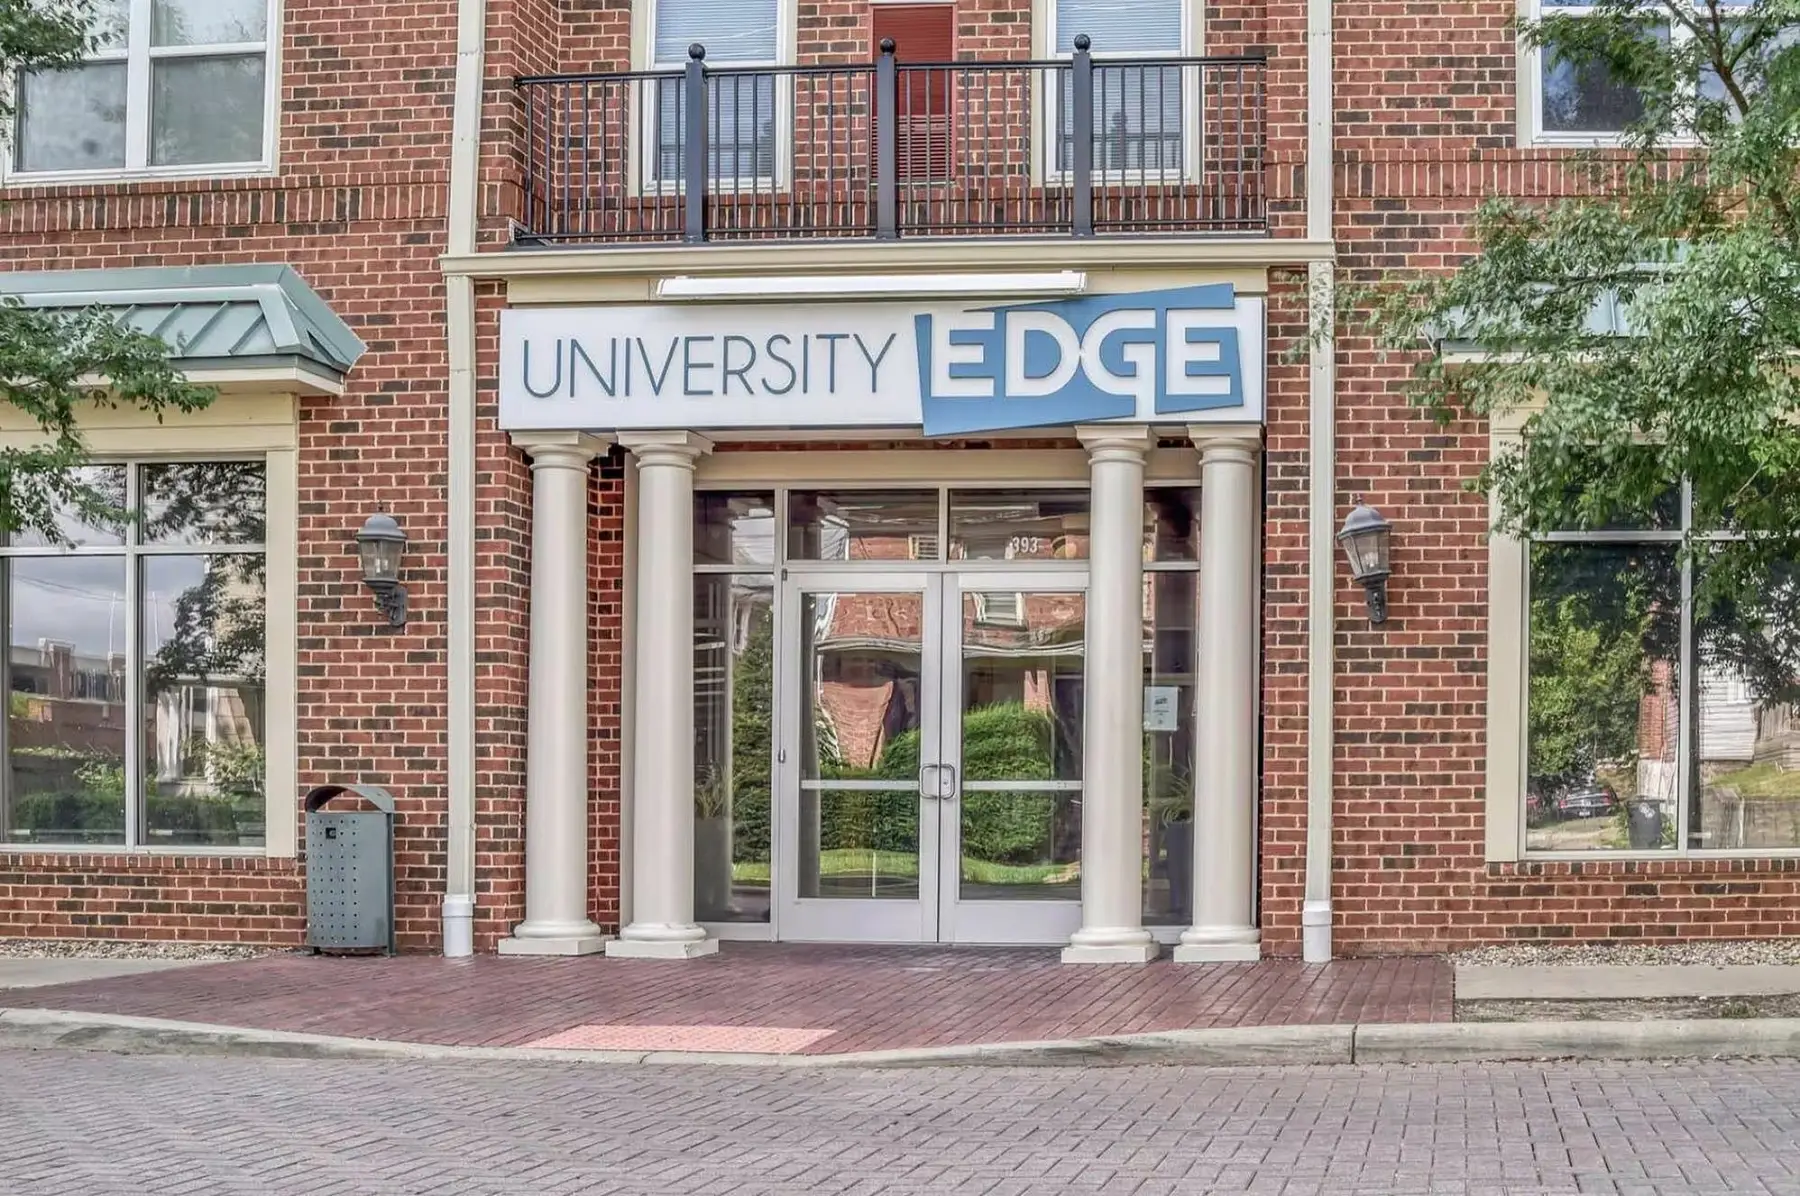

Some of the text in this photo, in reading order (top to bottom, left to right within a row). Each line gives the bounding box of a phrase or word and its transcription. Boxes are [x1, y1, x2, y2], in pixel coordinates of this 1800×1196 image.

[522, 308, 1232, 398] UNIVERSITY EDGE
[1012, 536, 1038, 553] 393
